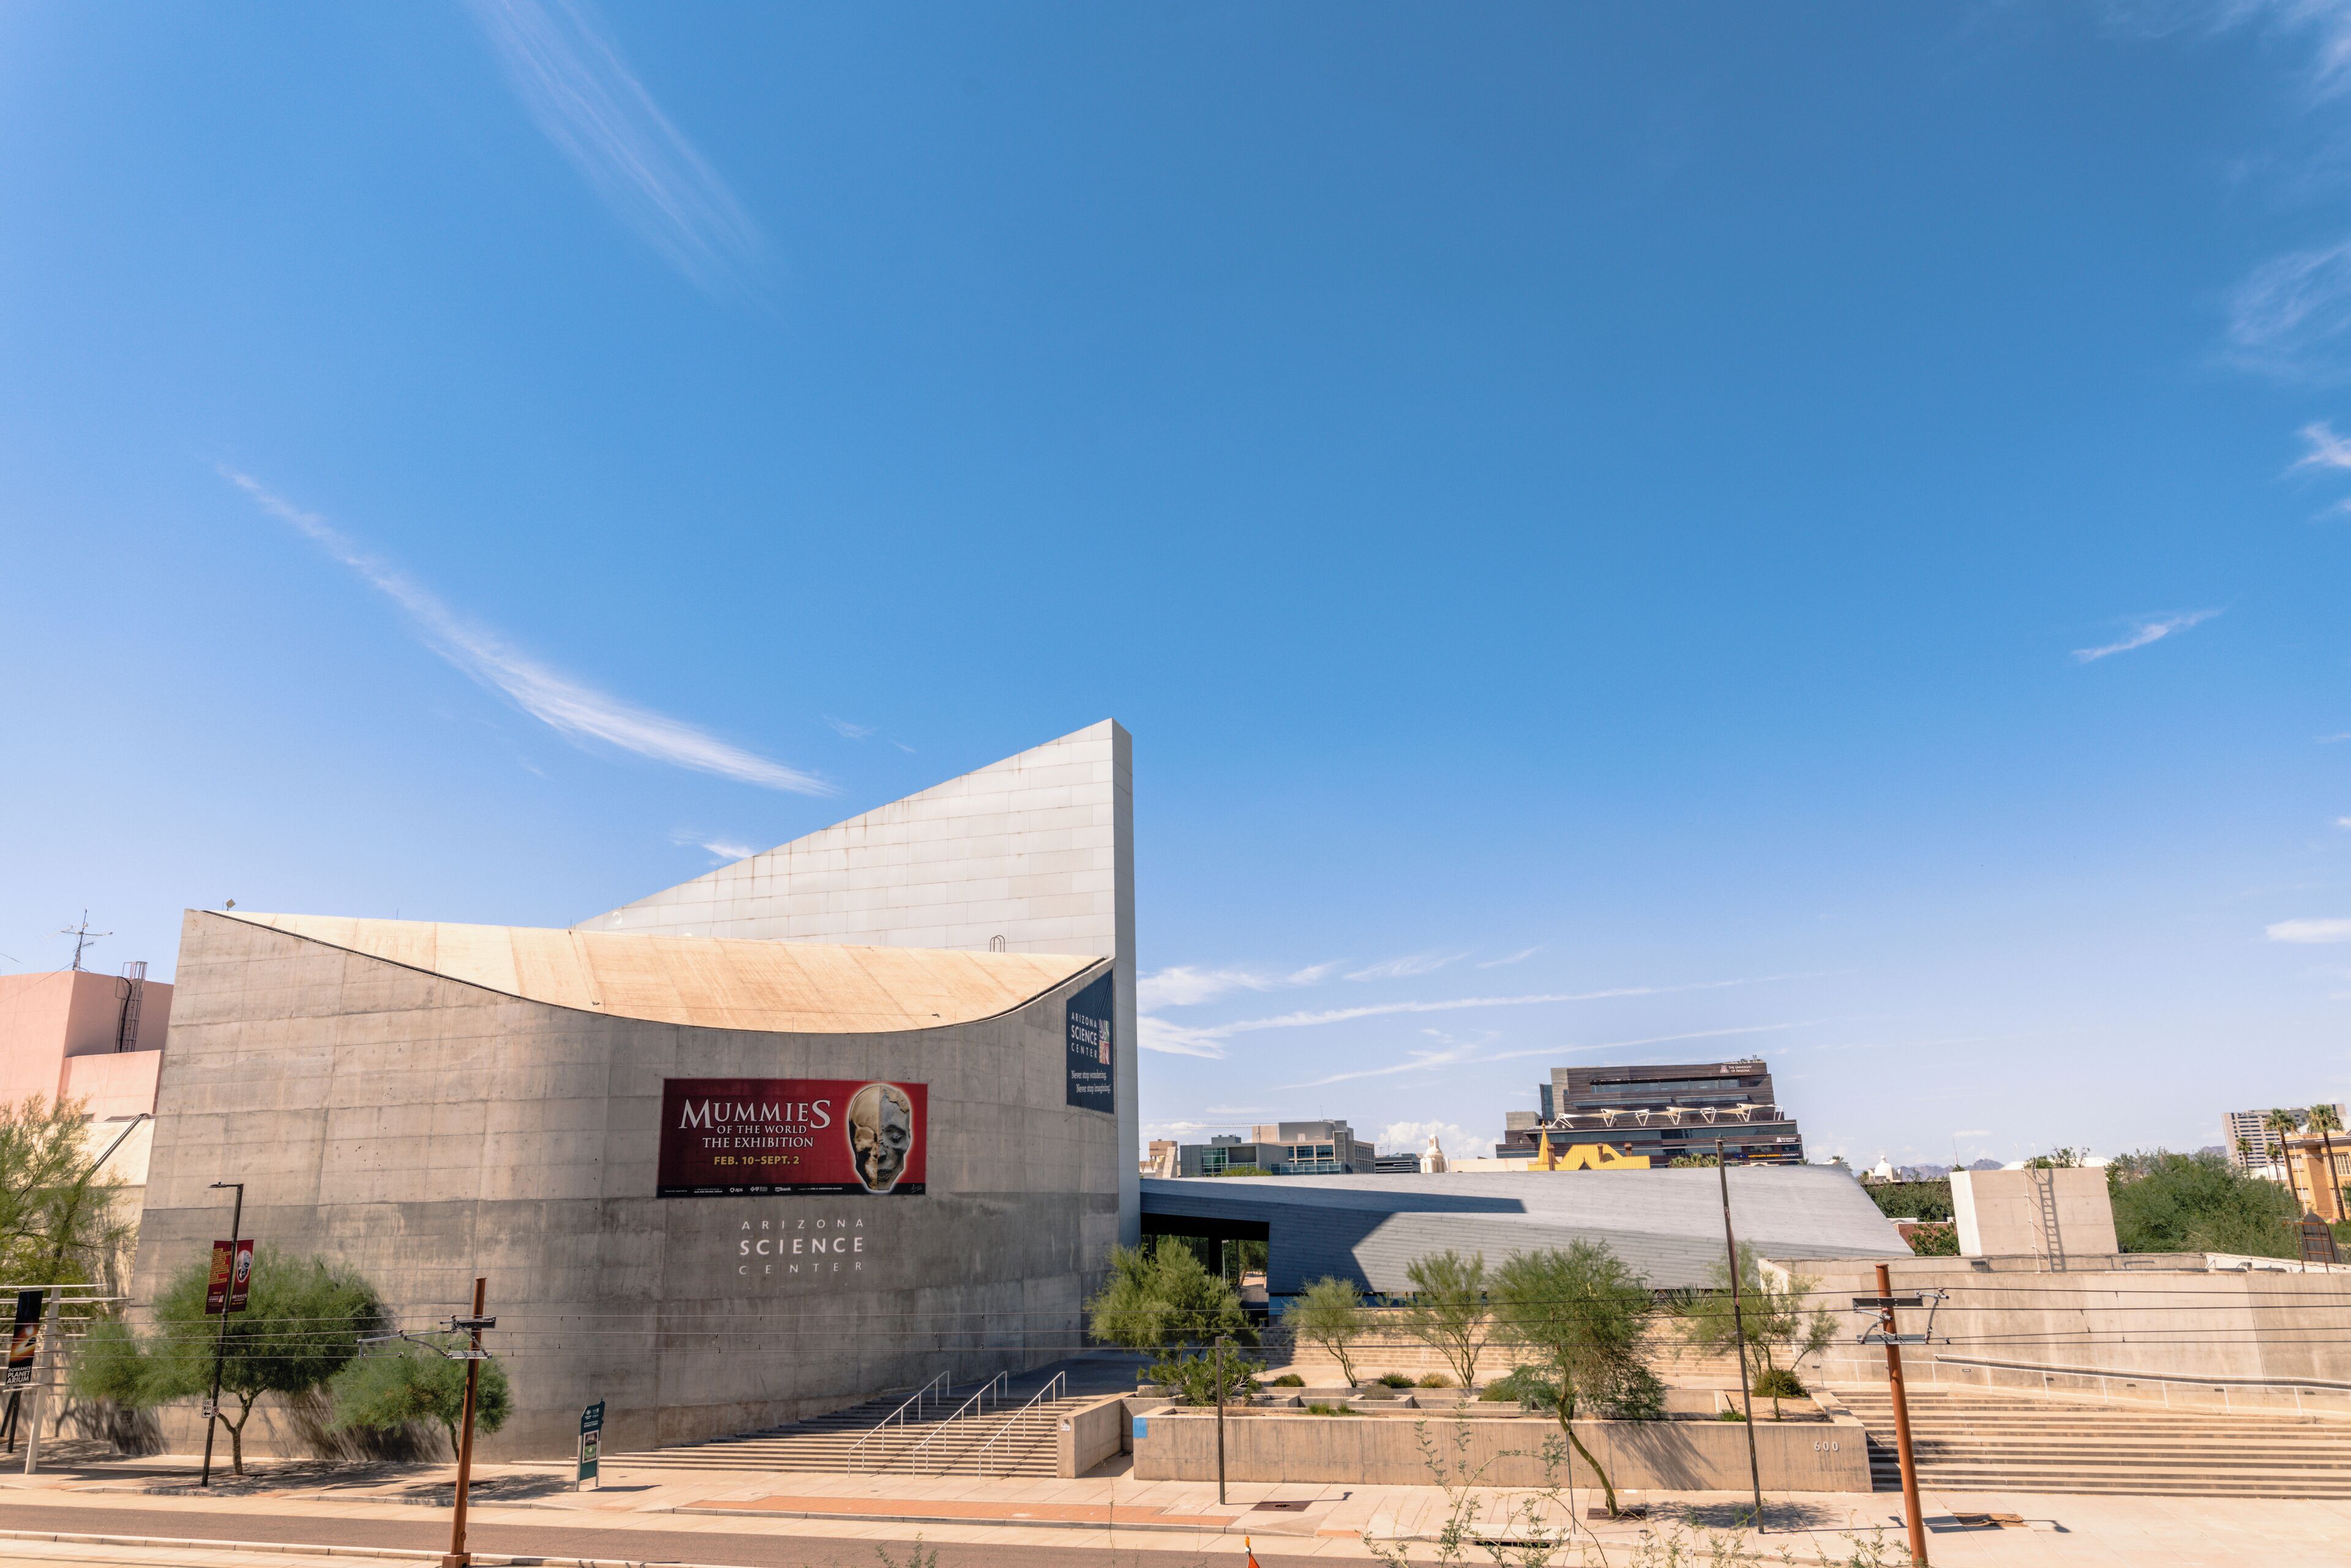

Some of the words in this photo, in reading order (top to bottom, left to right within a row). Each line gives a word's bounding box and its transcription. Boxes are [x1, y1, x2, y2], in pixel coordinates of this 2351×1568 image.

[1071, 1011, 1097, 1029] ARIZONA
[1071, 1024, 1097, 1046] SCIENCE
[1071, 1043, 1097, 1059] CENTER
[1071, 1070, 1082, 1079] Never
[1076, 1083, 1087, 1093] Never
[678, 1099, 831, 1129] MUMMIES
[717, 1125, 732, 1134] OF
[737, 1125, 760, 1134] THE
[765, 1125, 807, 1134] WORLD
[702, 1138, 730, 1148] THE
[735, 1137, 814, 1147] EXHIBITION
[714, 1156, 738, 1165] FEB.
[793, 1156, 800, 1165] 2
[741, 1219, 863, 1230] ARIZONA
[740, 1237, 863, 1255] SCIENCE
[739, 1262, 861, 1275] CENTER
[6, 1376, 29, 1384] ARIUM
[1814, 1441, 1839, 1452] 600
